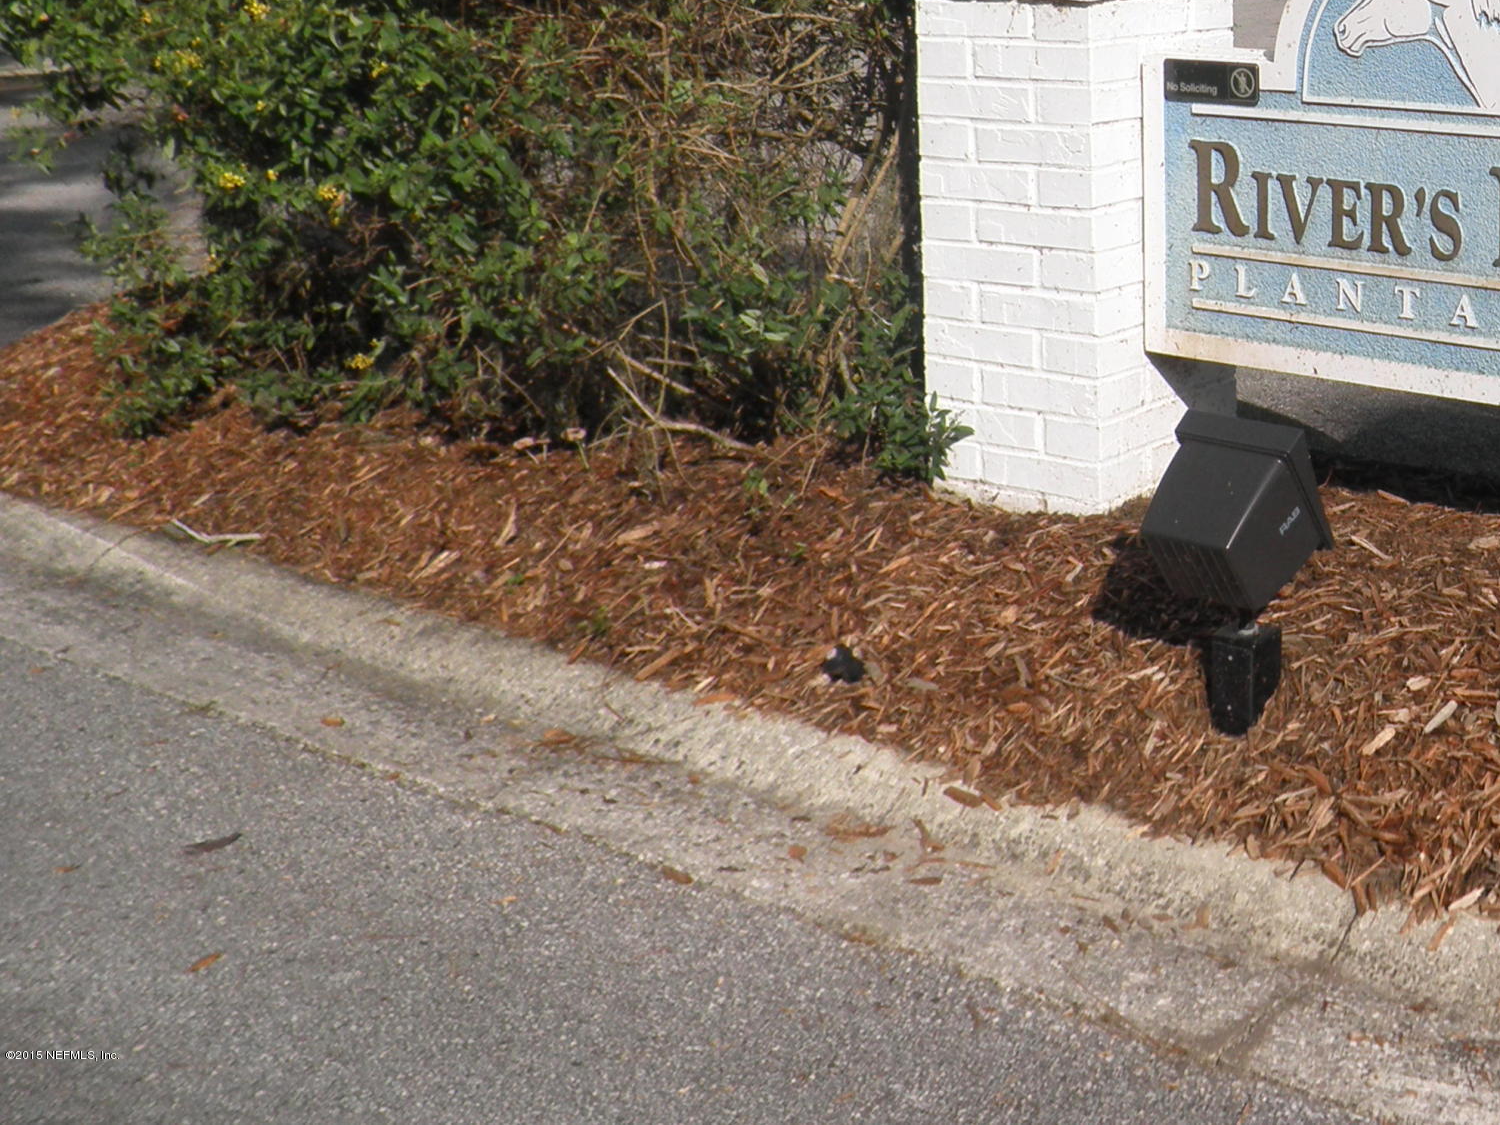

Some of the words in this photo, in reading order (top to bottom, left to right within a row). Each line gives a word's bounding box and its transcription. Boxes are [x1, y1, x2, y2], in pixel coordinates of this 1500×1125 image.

[1166, 81, 1179, 91] No
[1180, 82, 1218, 96] Soliciting
[1187, 138, 1463, 262] RIVER'S
